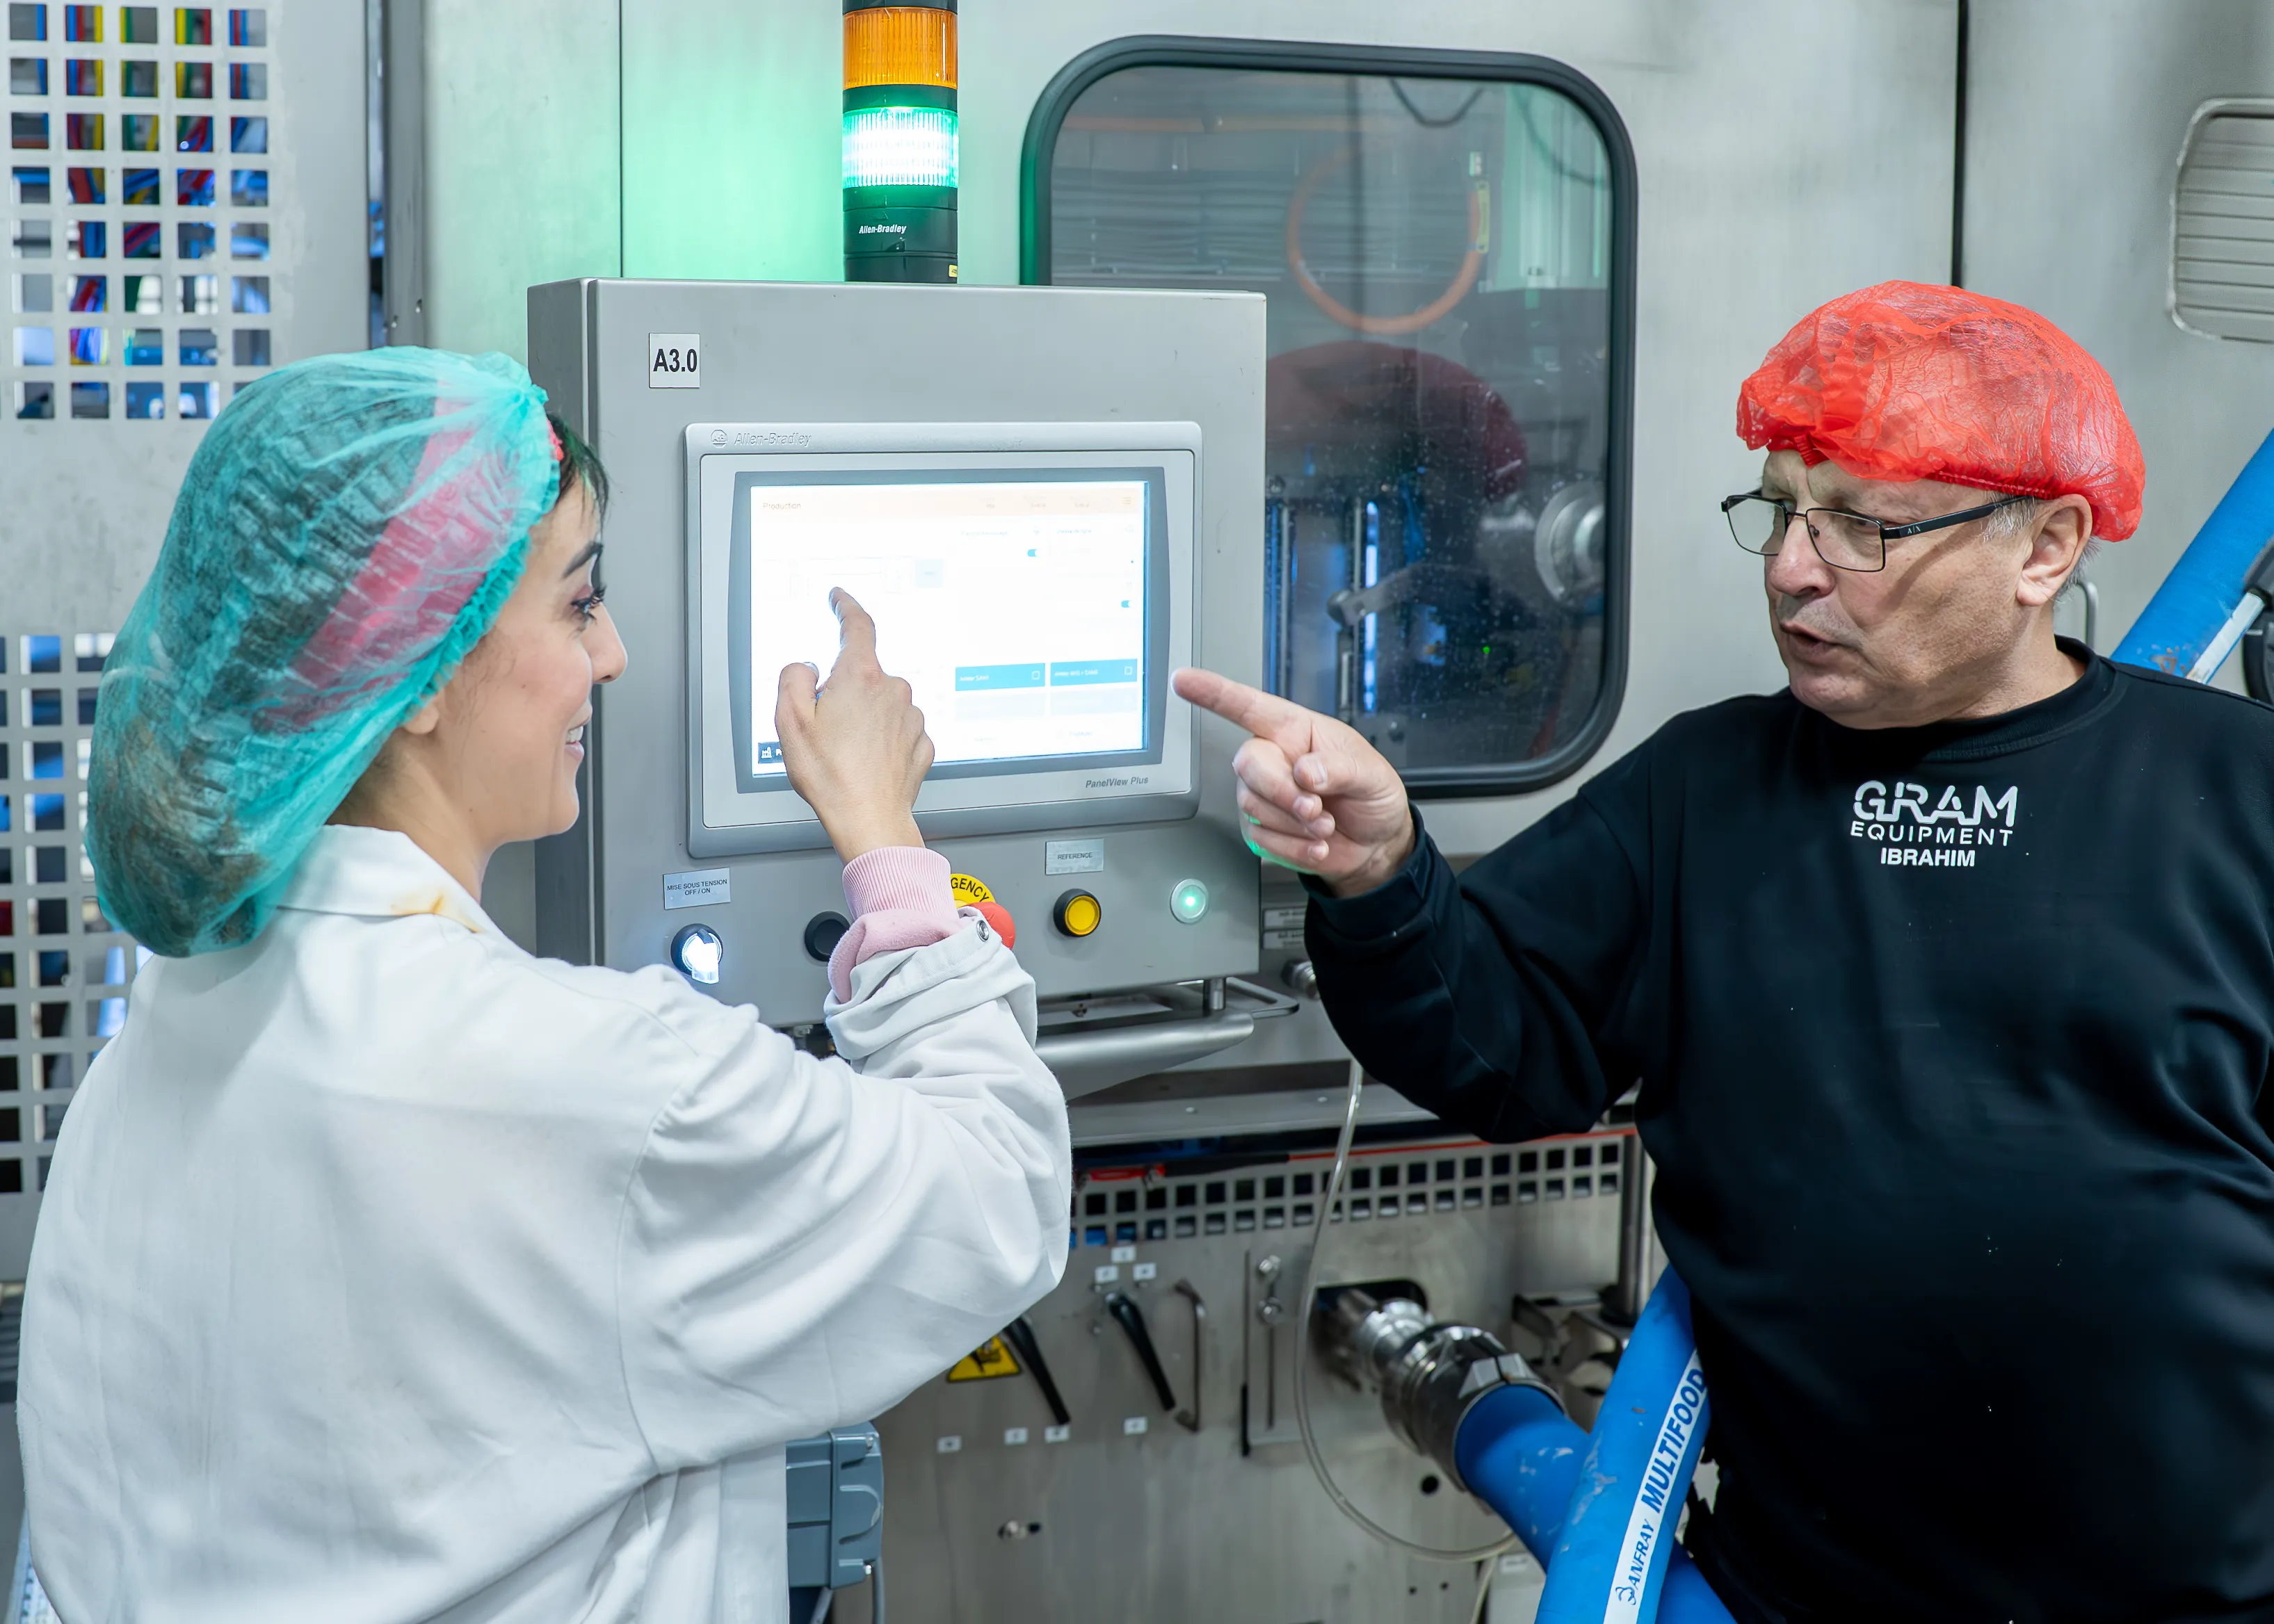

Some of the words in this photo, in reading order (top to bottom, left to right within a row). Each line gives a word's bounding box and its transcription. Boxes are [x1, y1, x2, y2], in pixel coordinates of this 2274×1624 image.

[859, 224, 907, 234] Allen-Bradley
[653, 348, 697, 373] A3.0
[734, 432, 812, 447] Allen-Bradley
[762, 502, 801, 510] Production
[1086, 778, 1128, 788] PanelView
[1130, 777, 1149, 785] Plus
[1853, 781, 2018, 827] GRAM
[1850, 820, 2013, 847] EQUIPMENT
[1057, 852, 1093, 860] REFERENCE
[1880, 847, 1976, 867] IBRAHIM
[1640, 1368, 1707, 1514] MULTIFOOD
